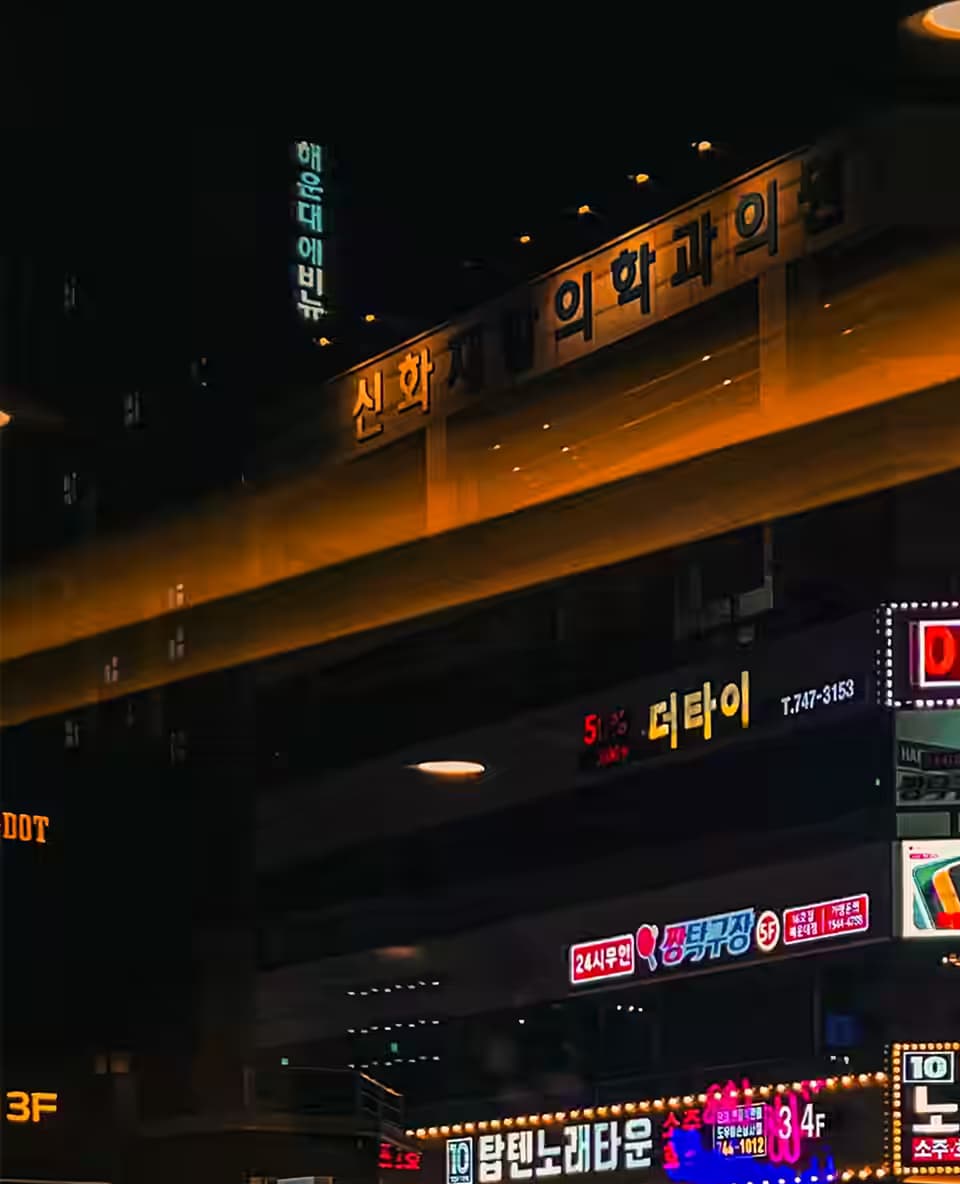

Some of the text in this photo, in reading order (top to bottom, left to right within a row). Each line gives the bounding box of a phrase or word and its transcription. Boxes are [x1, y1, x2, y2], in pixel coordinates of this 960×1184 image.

[352, 160, 843, 444] 신화의학과의
[648, 671, 749, 749] 더타이
[781, 679, 855, 716] T.747-3153
[661, 910, 757, 966] 짱탁구장
[575, 948, 632, 975] 24시무인
[911, 1056, 948, 1080] 10
[6, 1091, 57, 1122] 3F
[449, 1142, 470, 1175] 10
[479, 1118, 653, 1182] 탑텐노래타운
